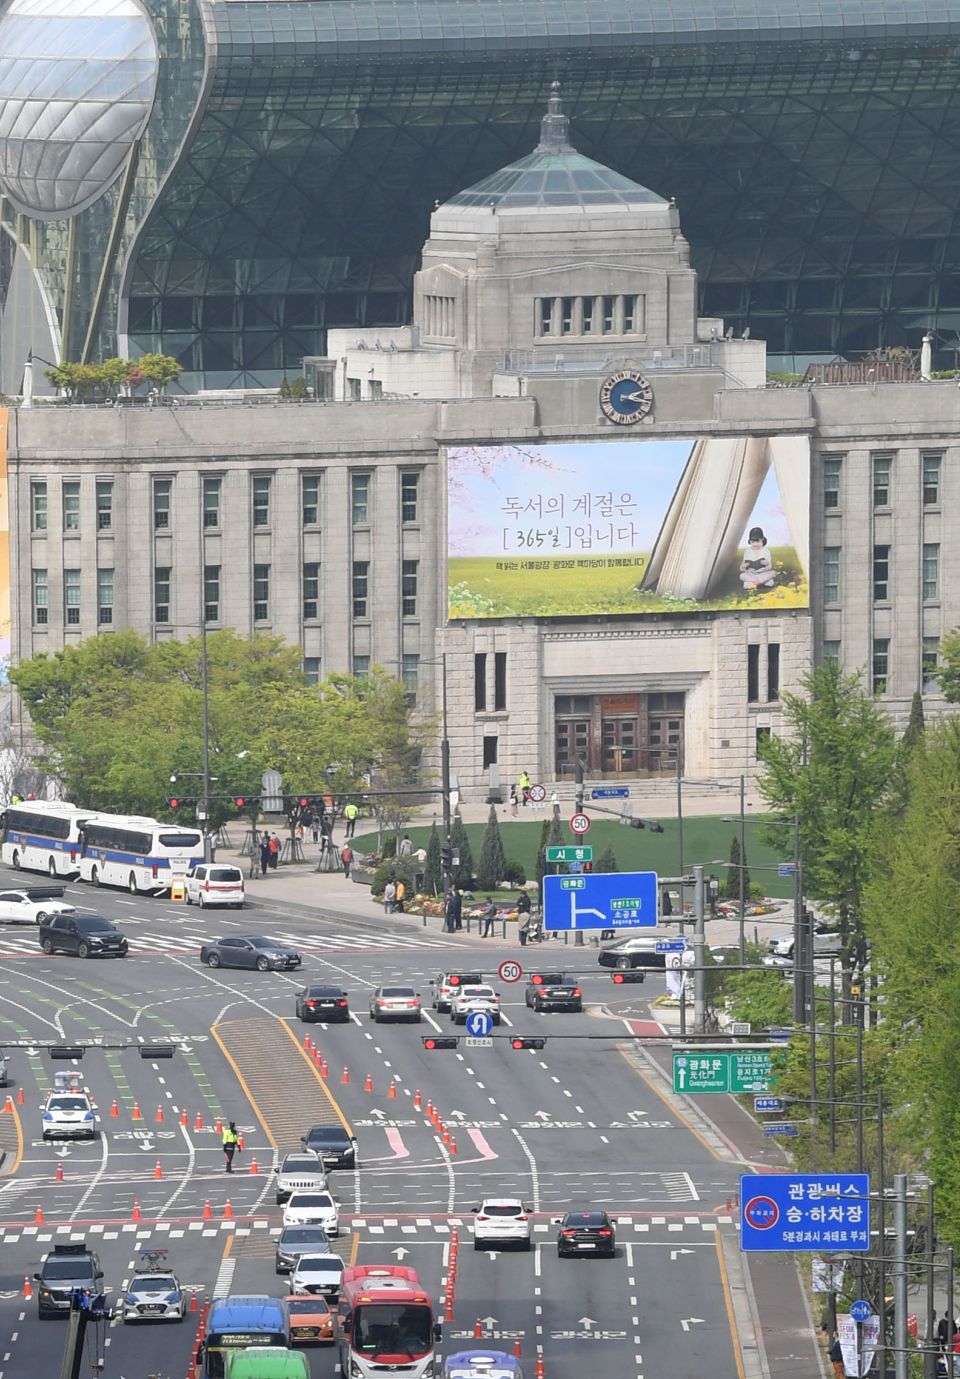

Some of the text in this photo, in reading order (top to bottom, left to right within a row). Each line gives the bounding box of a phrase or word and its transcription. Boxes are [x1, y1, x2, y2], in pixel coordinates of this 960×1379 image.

[501, 491, 637, 520] 독서의 계절은
[574, 818, 586, 829] 50
[556, 849, 584, 860] 시청
[614, 910, 638, 918] 소공로
[503, 966, 518, 978] 50
[689, 1060, 722, 1070] 광화문
[788, 1183, 860, 1200] 관광버스
[786, 1205, 863, 1223] 승·하차장
[782, 1231, 867, 1242] 5분경과시 과태료 부과
